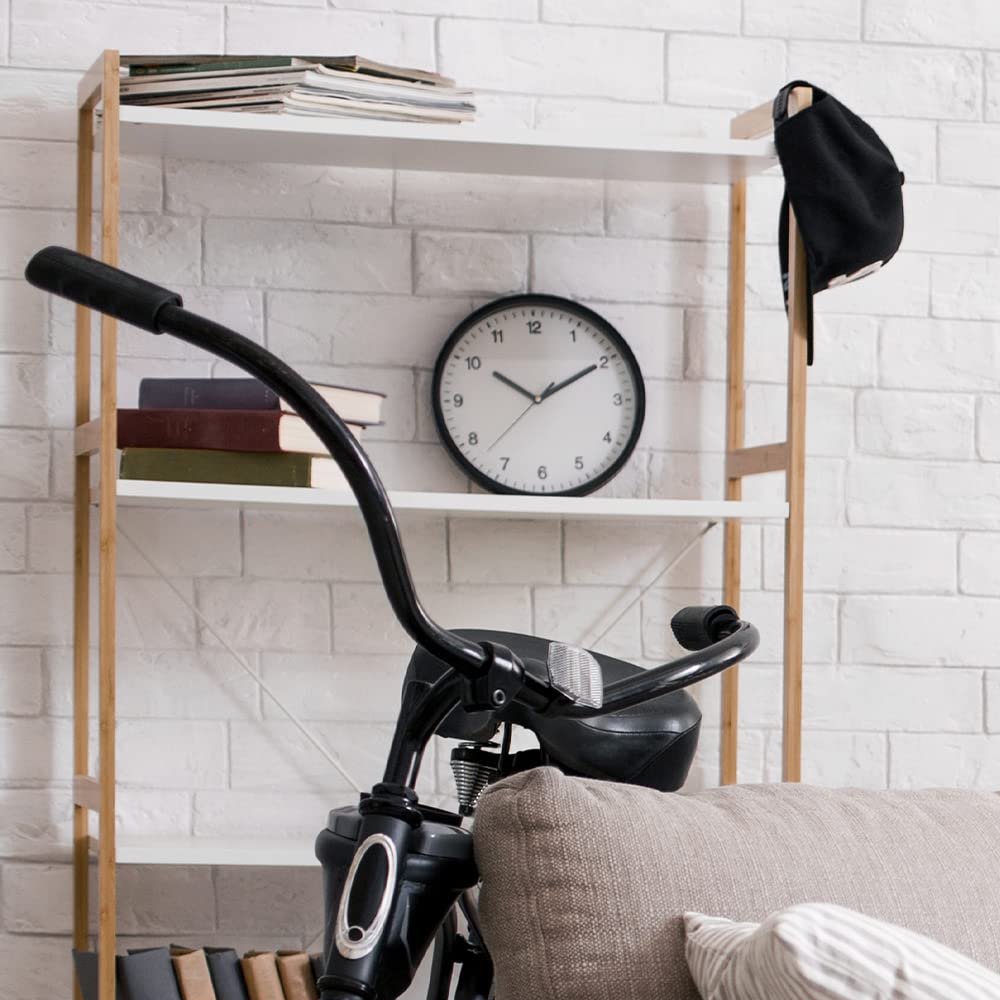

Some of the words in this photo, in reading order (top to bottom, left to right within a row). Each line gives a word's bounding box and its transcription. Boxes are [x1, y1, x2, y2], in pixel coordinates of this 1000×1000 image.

[526, 320, 542, 335] 12
[491, 329, 503, 343] 11
[569, 330, 576, 342] 1
[465, 355, 481, 370] 10
[599, 356, 609, 369] 2
[453, 393, 464, 408] 9
[613, 393, 623, 406] 3
[468, 431, 478, 446] 8
[602, 431, 612, 444] 4
[500, 457, 510, 471] 7
[574, 456, 584, 470] 5
[537, 465, 548, 480] 6
